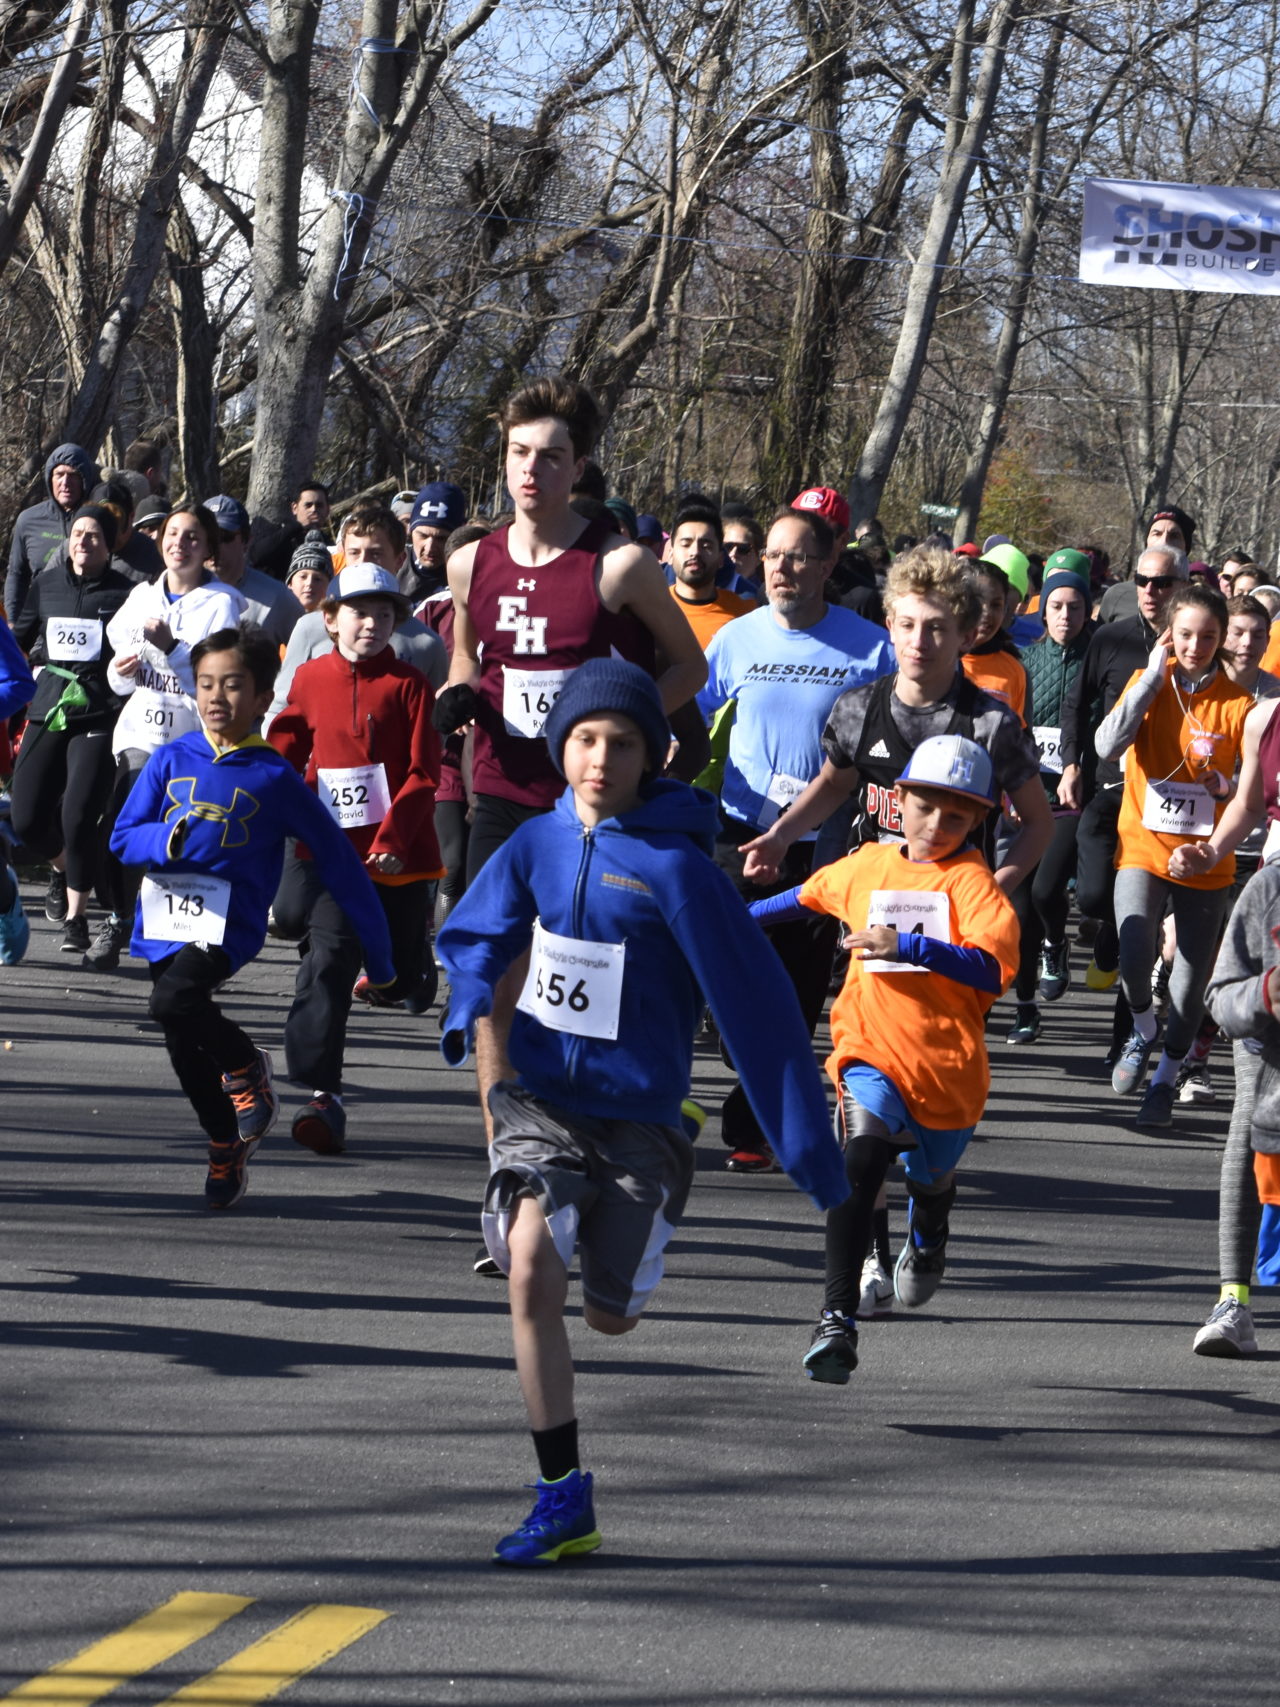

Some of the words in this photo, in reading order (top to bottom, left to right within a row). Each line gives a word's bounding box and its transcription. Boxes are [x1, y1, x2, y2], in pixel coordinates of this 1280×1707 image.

[296, 560, 319, 569] THE
[57, 631, 88, 646] 263
[743, 675, 786, 683] TRACK
[803, 678, 844, 687] FIELD
[747, 664, 849, 679] MESSIAH
[144, 709, 174, 728] 501
[951, 757, 974, 782] H
[331, 785, 370, 808] 252
[338, 809, 364, 820] David
[866, 782, 906, 833] PIE
[1160, 797, 1196, 816] 471
[1160, 817, 1196, 828] Vivienne
[165, 894, 204, 917] 143
[536, 968, 590, 1013] 656
